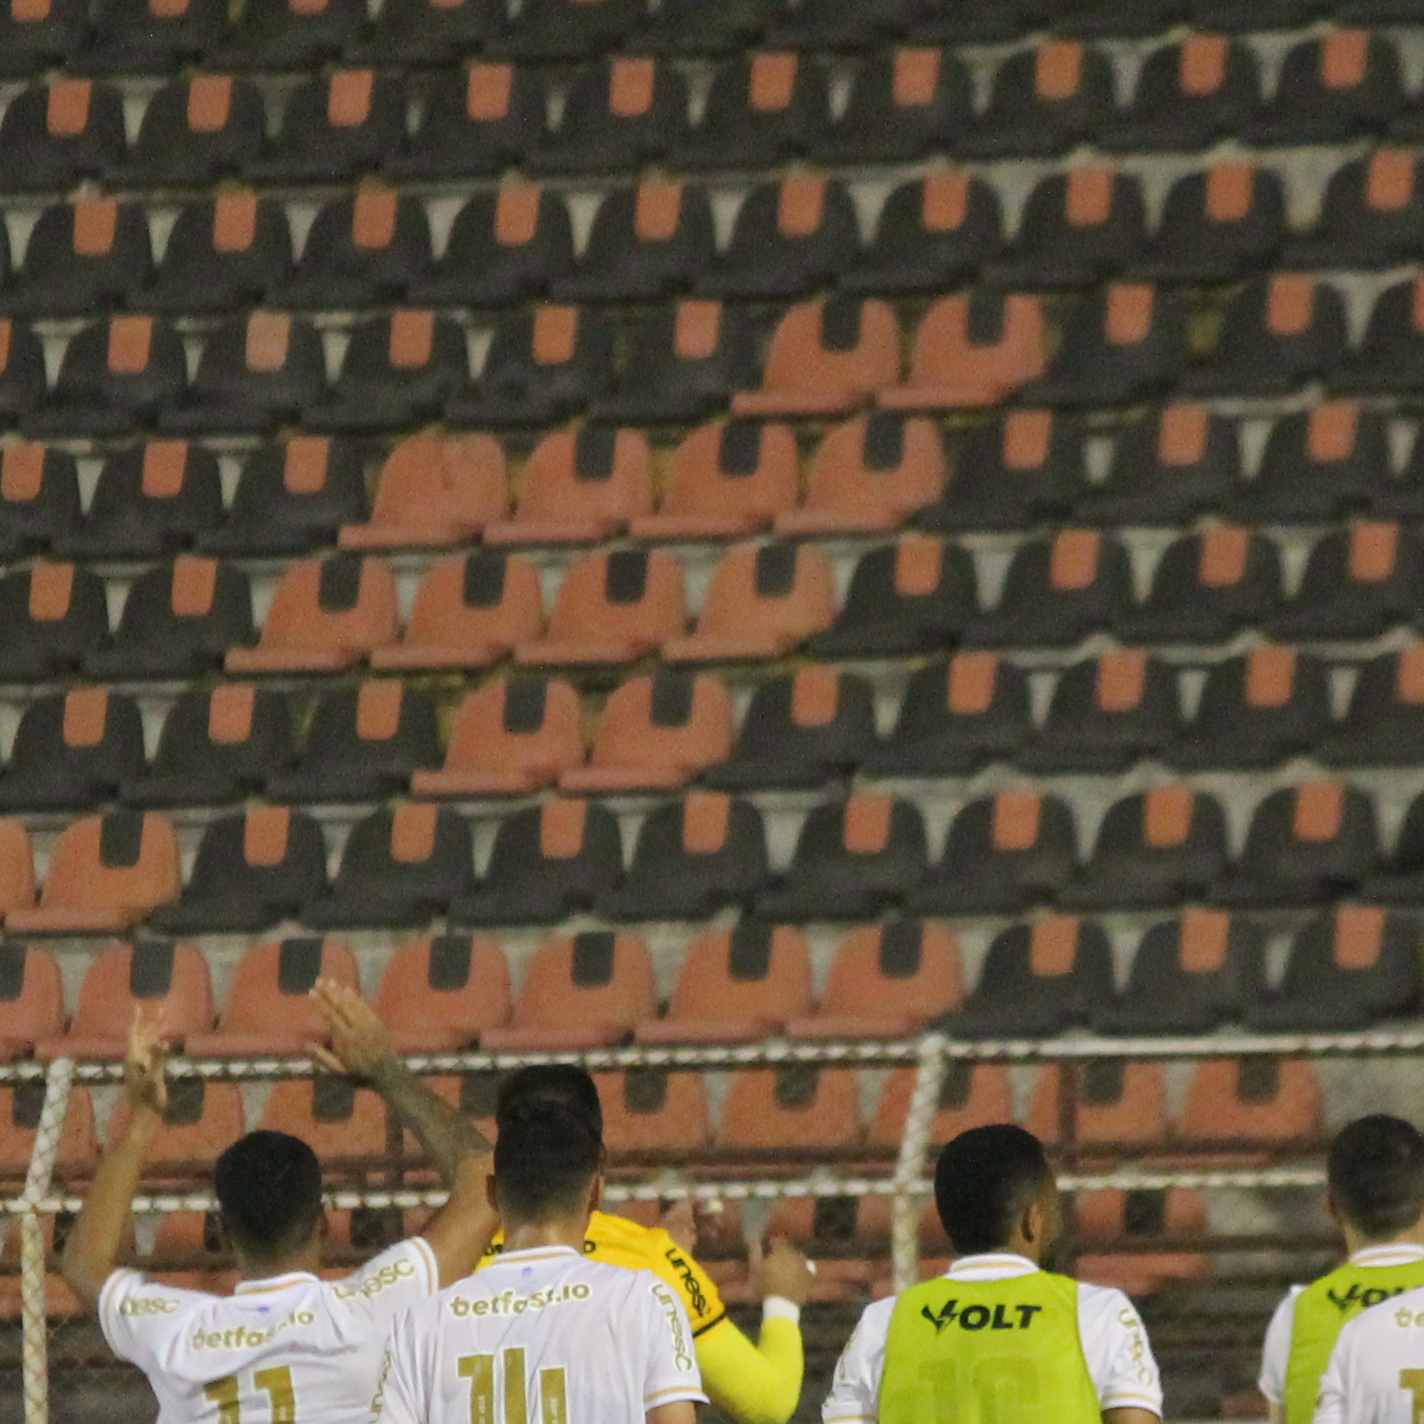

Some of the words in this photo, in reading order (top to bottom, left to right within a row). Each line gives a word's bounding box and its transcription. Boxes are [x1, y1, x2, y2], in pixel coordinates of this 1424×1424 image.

[449, 1283, 590, 1318] betfast.io
[1327, 1283, 1422, 1313] VO
[191, 1309, 315, 1350] betfaio
[650, 1283, 693, 1373] unesc
[920, 1299, 1043, 1336] VOLT
